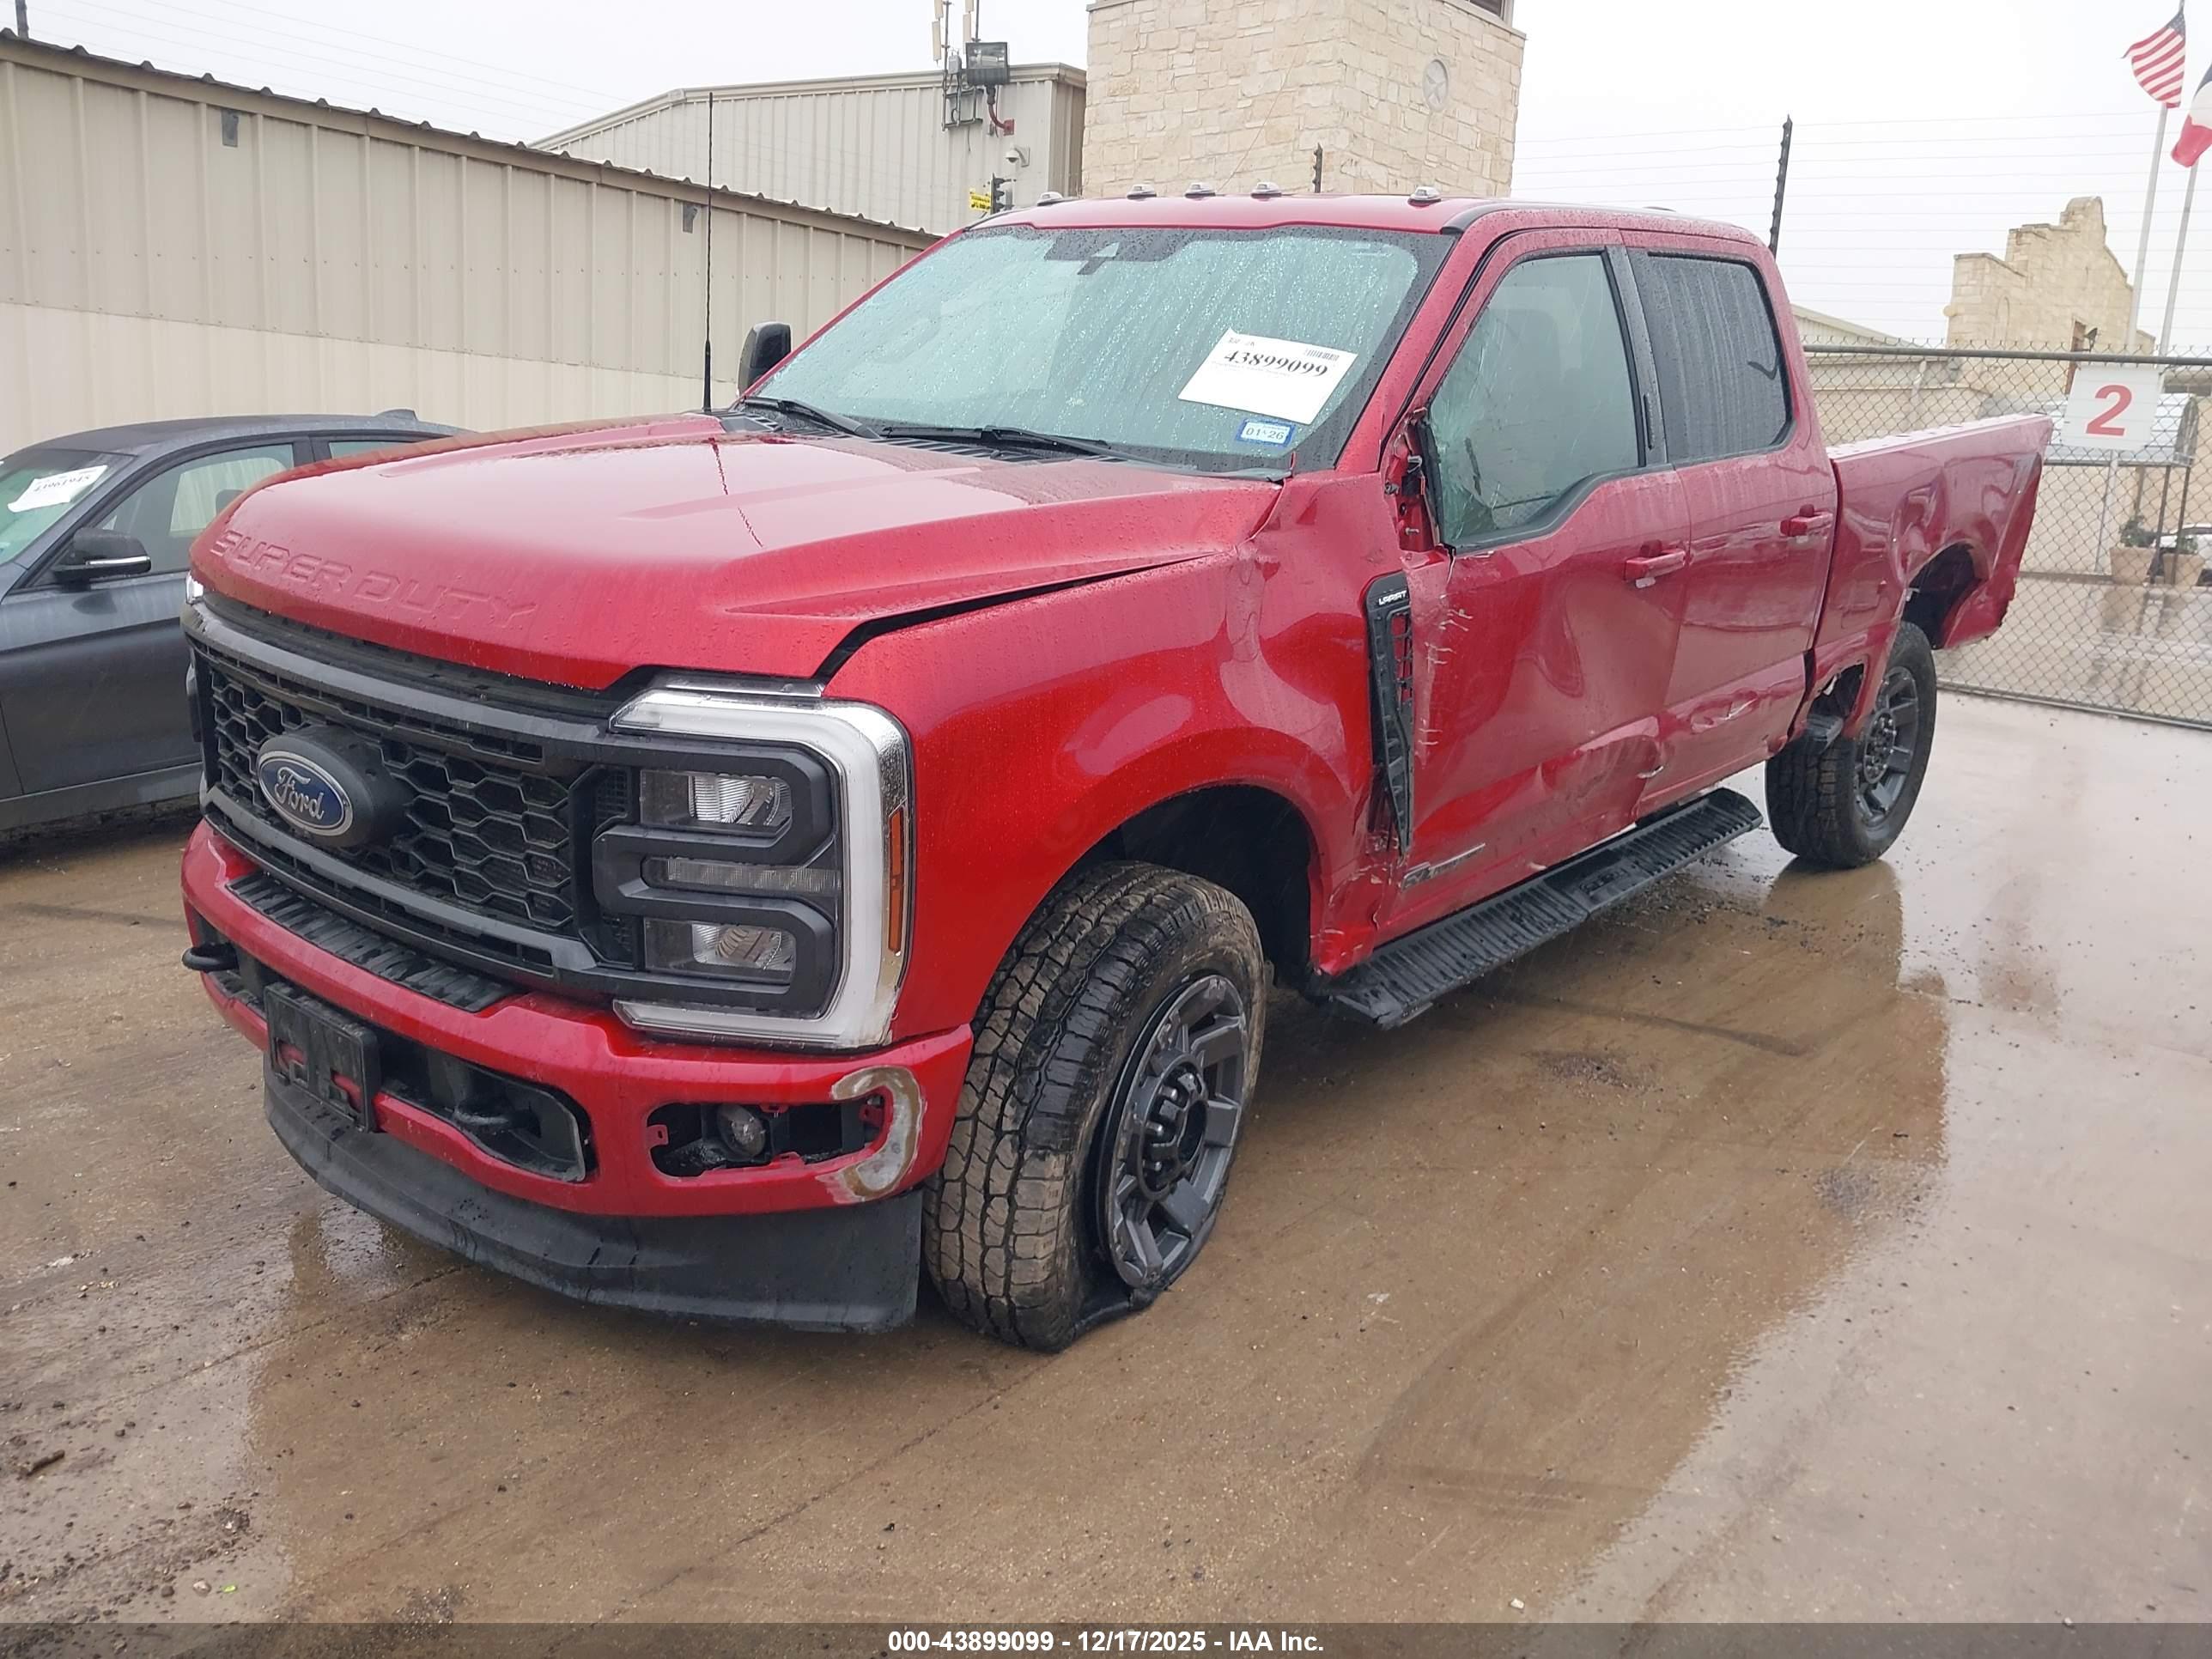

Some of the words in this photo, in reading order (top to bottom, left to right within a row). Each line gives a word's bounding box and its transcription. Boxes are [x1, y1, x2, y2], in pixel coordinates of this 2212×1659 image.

[1224, 349, 1328, 377] 43899099
[2085, 384, 2133, 437] 2
[210, 529, 353, 592] SUPER
[354, 570, 540, 629] DUTY
[274, 766, 325, 820] Ford
